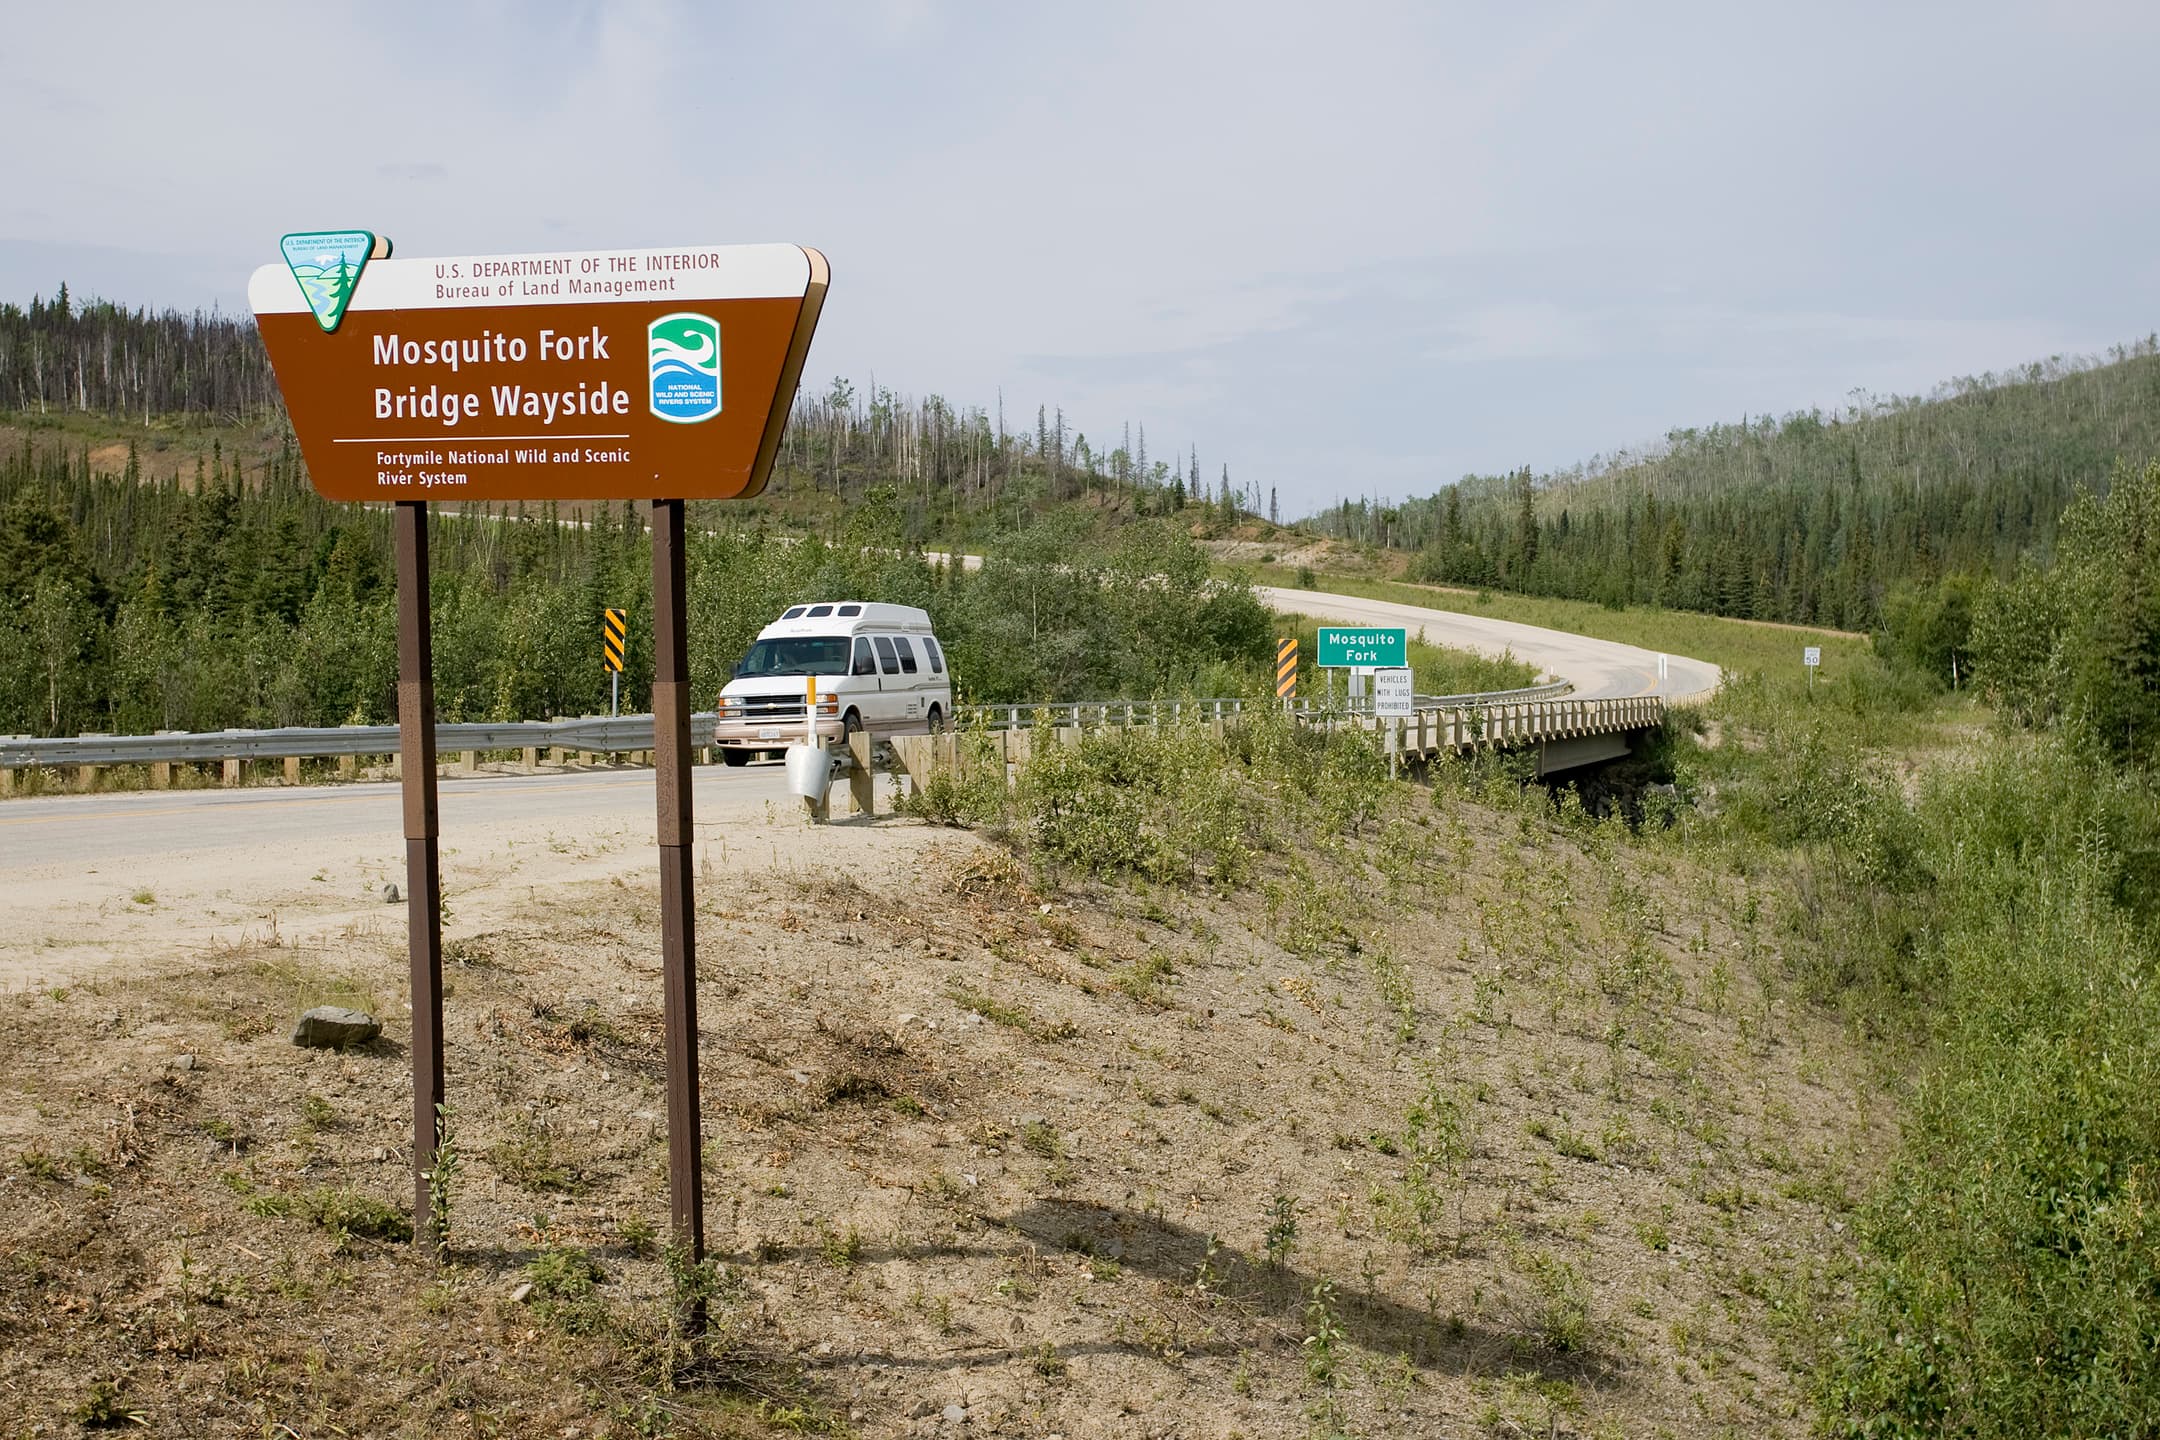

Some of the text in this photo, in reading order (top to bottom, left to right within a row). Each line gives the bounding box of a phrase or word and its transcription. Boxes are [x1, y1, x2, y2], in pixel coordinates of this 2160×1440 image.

[435, 253, 720, 279] U.S. DEPARTMENT OF THE INTERIOR
[436, 275, 675, 299] Bureau of Land Management
[373, 326, 610, 372] Mosquito Fork
[374, 381, 629, 426] Bridge Wayside
[377, 448, 630, 469] Fortymile National Wild and Scenic
[377, 471, 467, 488] River System
[1329, 633, 1395, 647] Mosquito
[1346, 650, 1377, 661] Fork
[1379, 675, 1408, 684] VEHICLES
[1377, 688, 1410, 697] WITH LUGS
[1377, 701, 1409, 710] PROHIBITED
